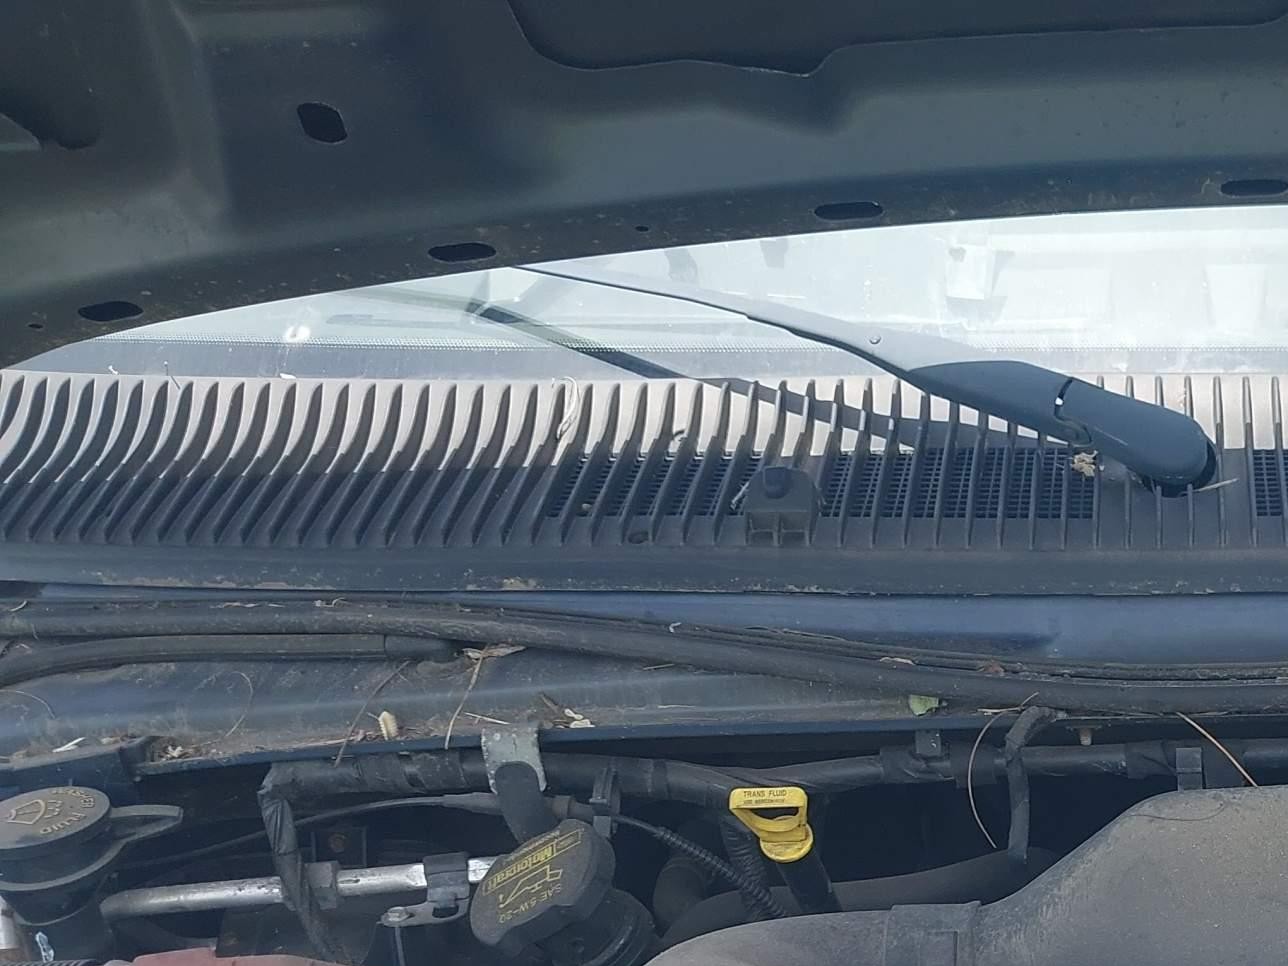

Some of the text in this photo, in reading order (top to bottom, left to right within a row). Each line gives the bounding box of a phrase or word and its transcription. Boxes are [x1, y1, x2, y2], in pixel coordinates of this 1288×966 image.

[743, 789, 787, 798] TRANS FLUID
[39, 811, 86, 833] FLUID
[487, 845, 553, 891] Motorcraft
